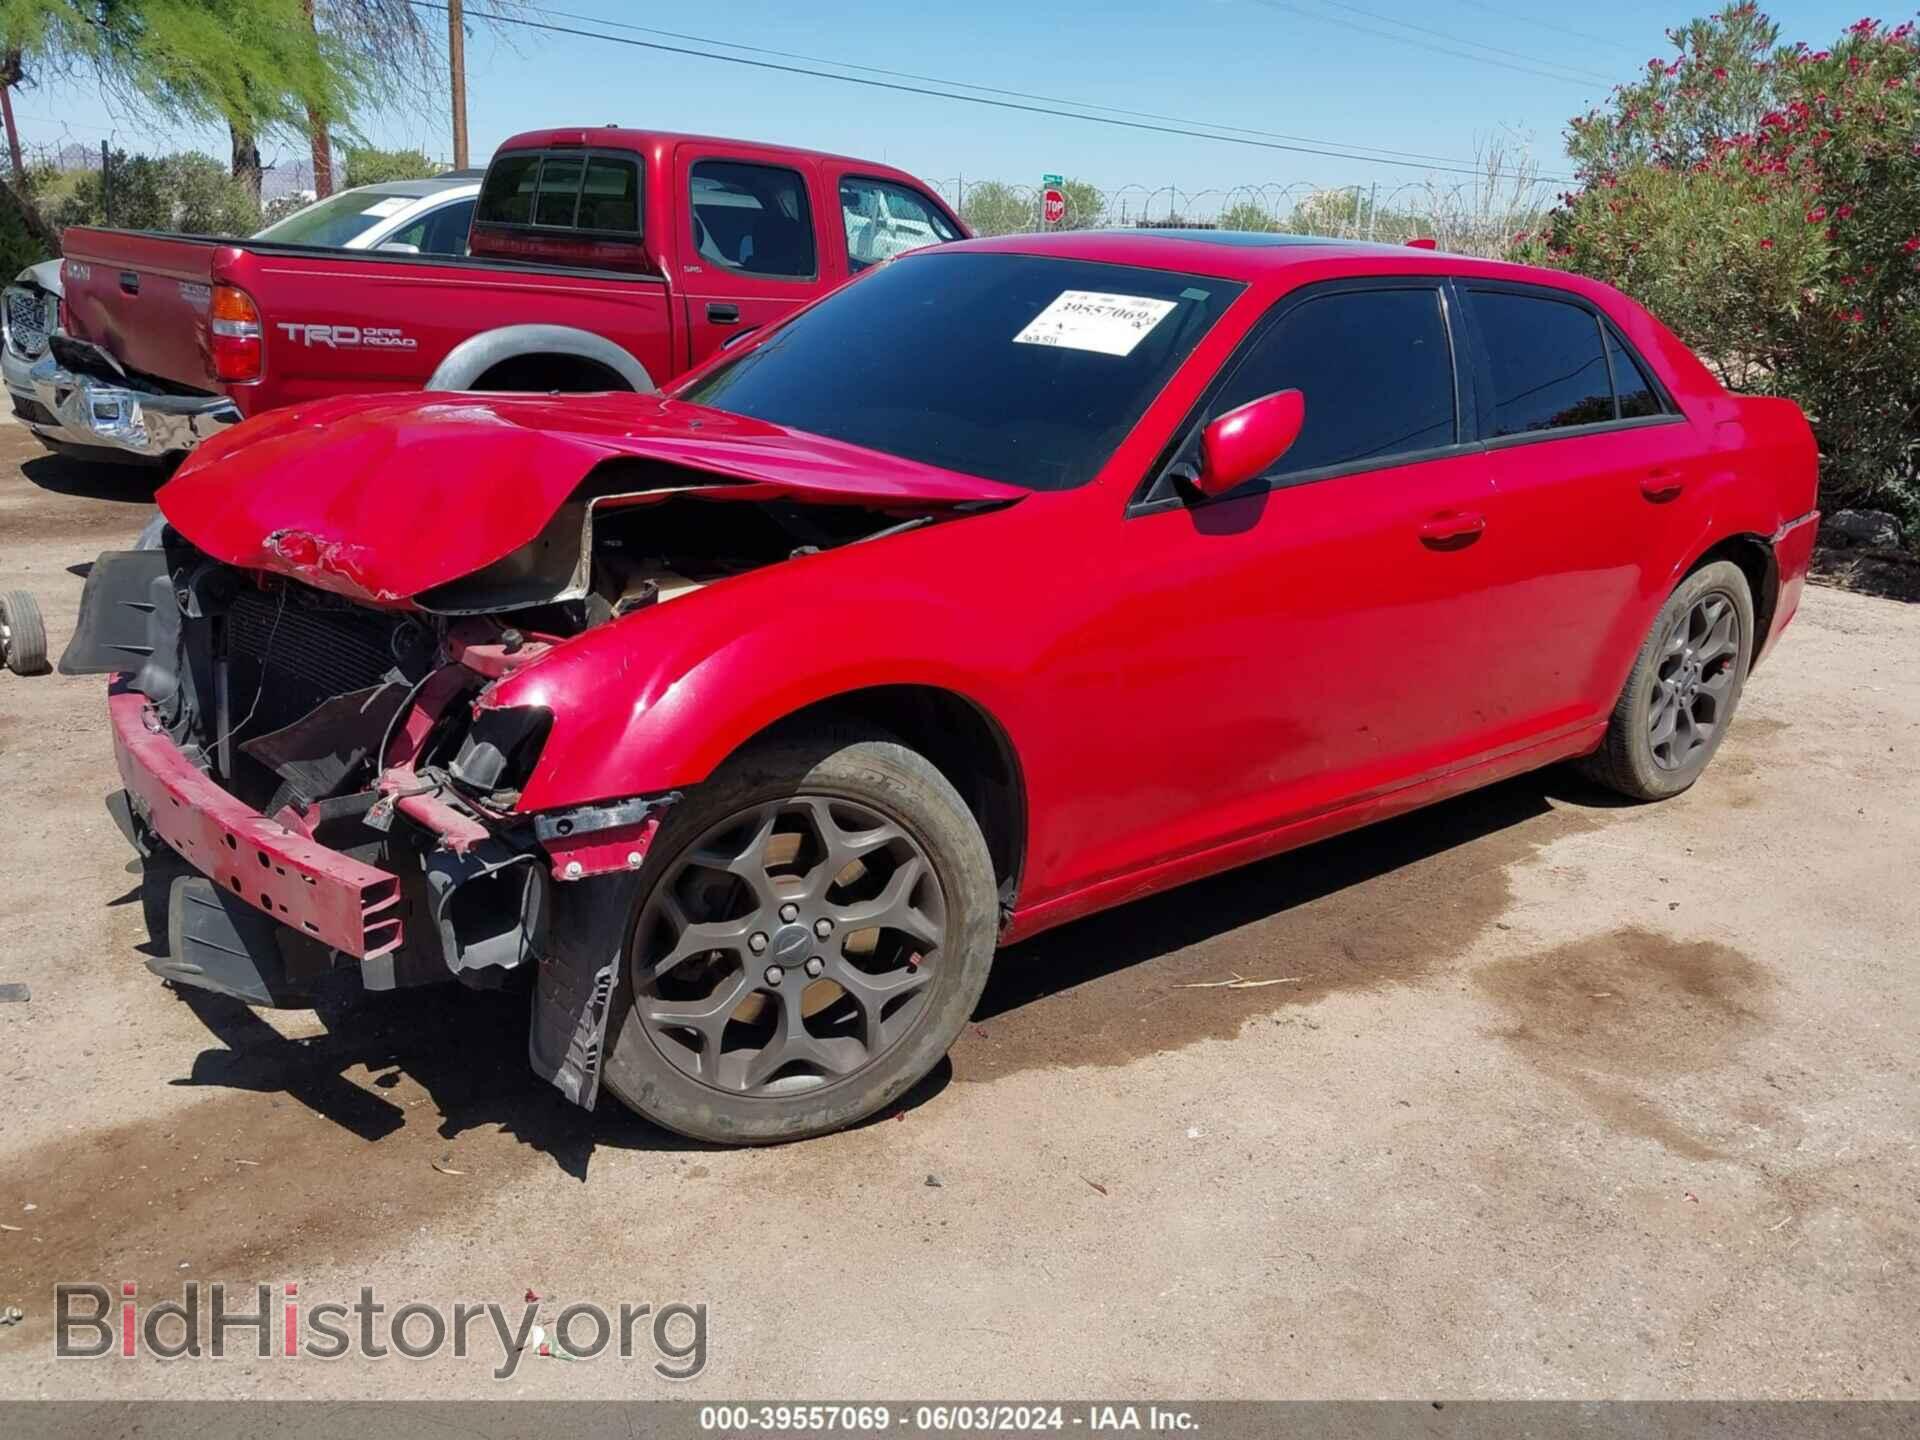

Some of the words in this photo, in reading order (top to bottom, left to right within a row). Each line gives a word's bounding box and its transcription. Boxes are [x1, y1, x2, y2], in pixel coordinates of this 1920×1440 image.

[277, 322, 361, 348] TRD
[363, 327, 402, 337] OFF
[363, 337, 418, 348] ROAD
